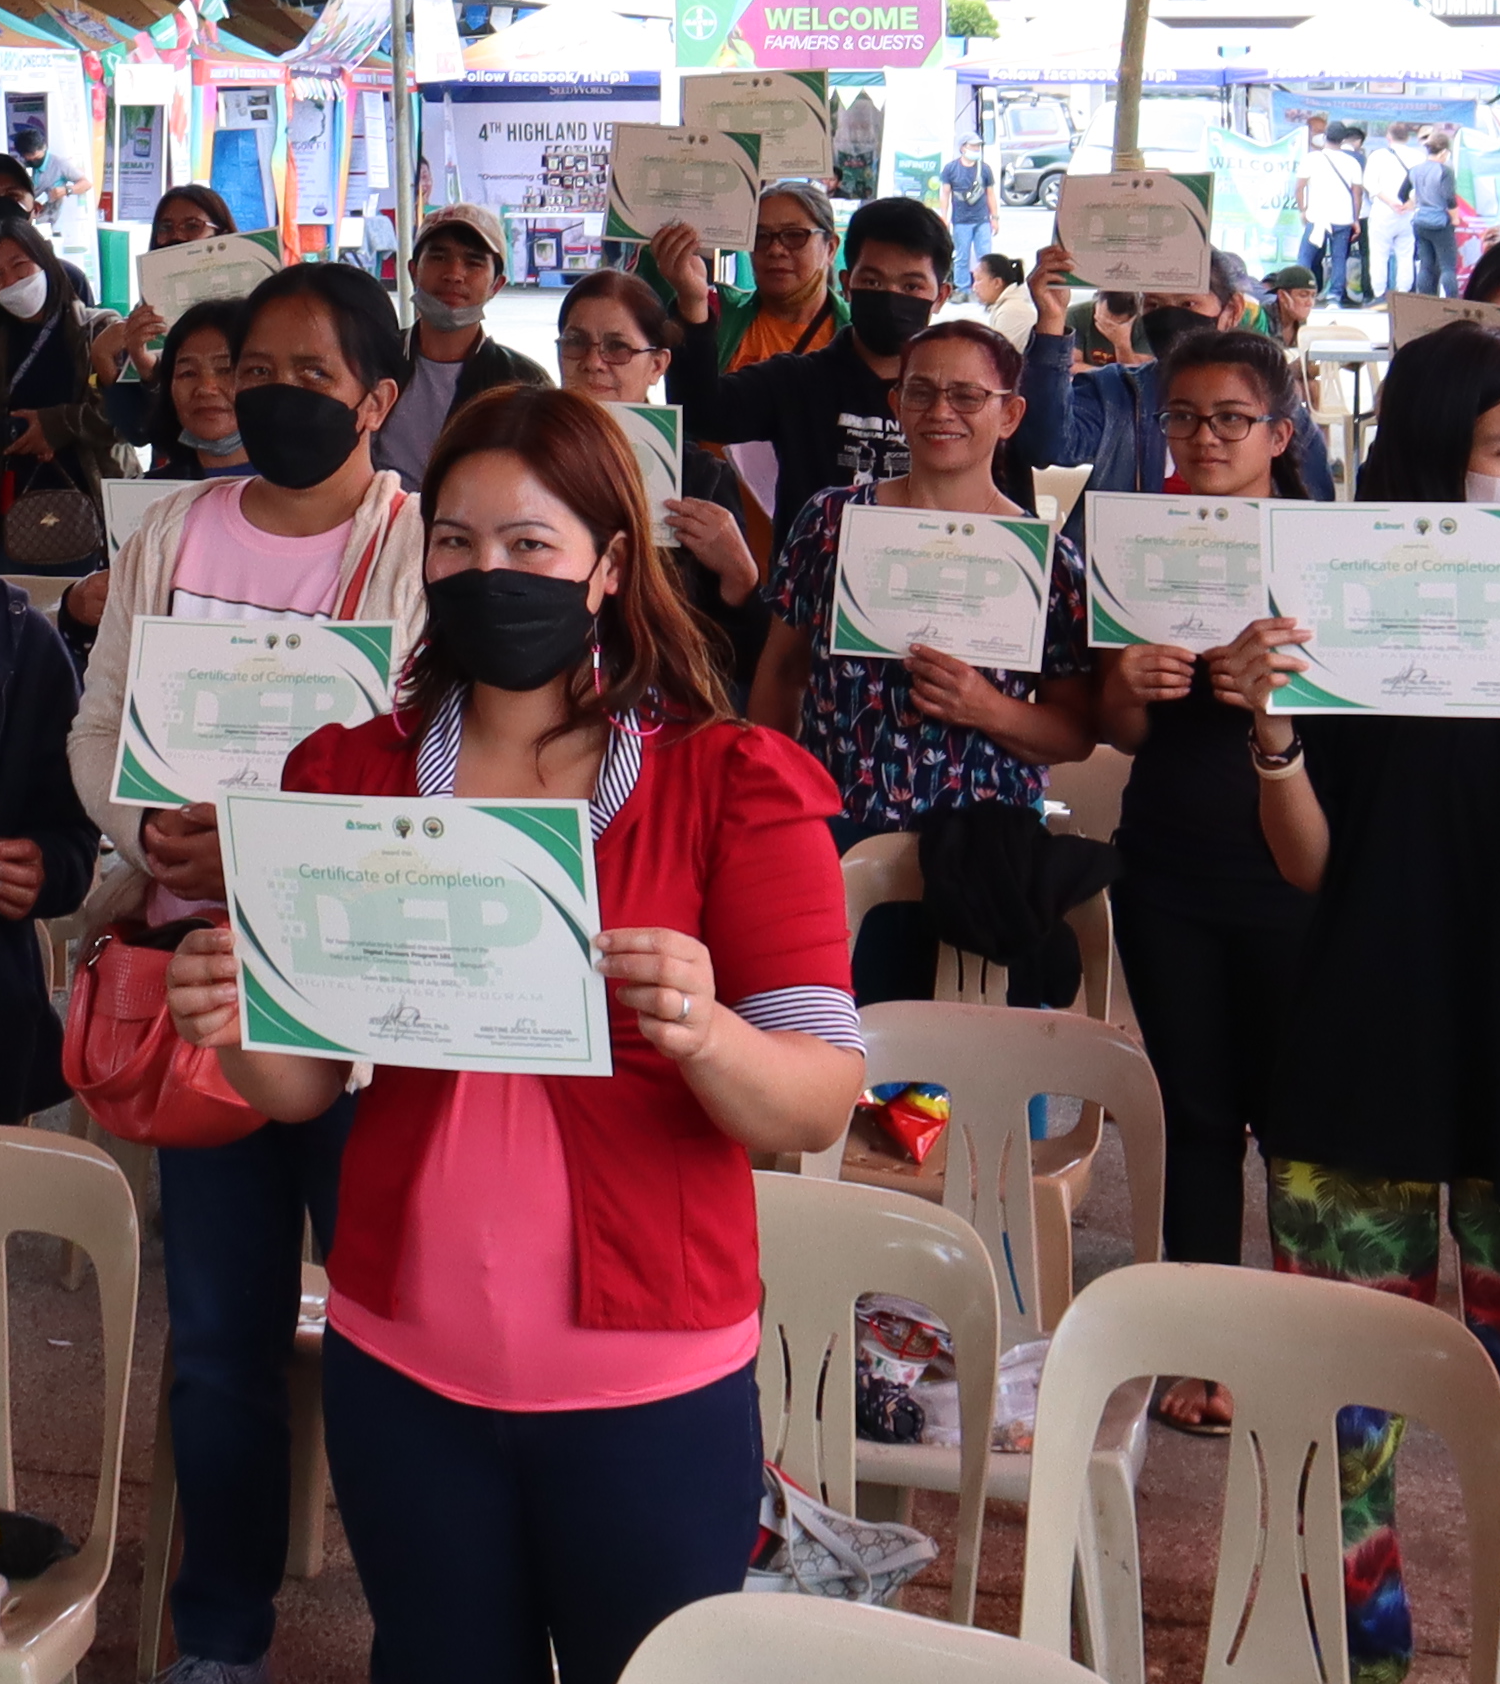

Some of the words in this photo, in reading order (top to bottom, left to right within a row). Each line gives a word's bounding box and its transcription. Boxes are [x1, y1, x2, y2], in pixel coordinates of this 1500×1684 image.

[764, 5, 920, 31] WELCOME
[764, 34, 840, 51] FARMERS
[842, 35, 855, 50] &
[857, 34, 925, 51] GUESTS
[458, 69, 507, 84] Follow
[509, 69, 630, 86] facebook/TNTph
[507, 122, 588, 142] HIGHLAND
[1329, 557, 1402, 575] Certificate
[1405, 557, 1422, 574] of
[188, 667, 244, 685] Certificate
[246, 668, 260, 684] of
[262, 669, 337, 687] Completion
[356, 821, 382, 832] Smart
[299, 863, 380, 884] Certificate
[384, 869, 400, 885] of
[404, 870, 505, 890] Completion
